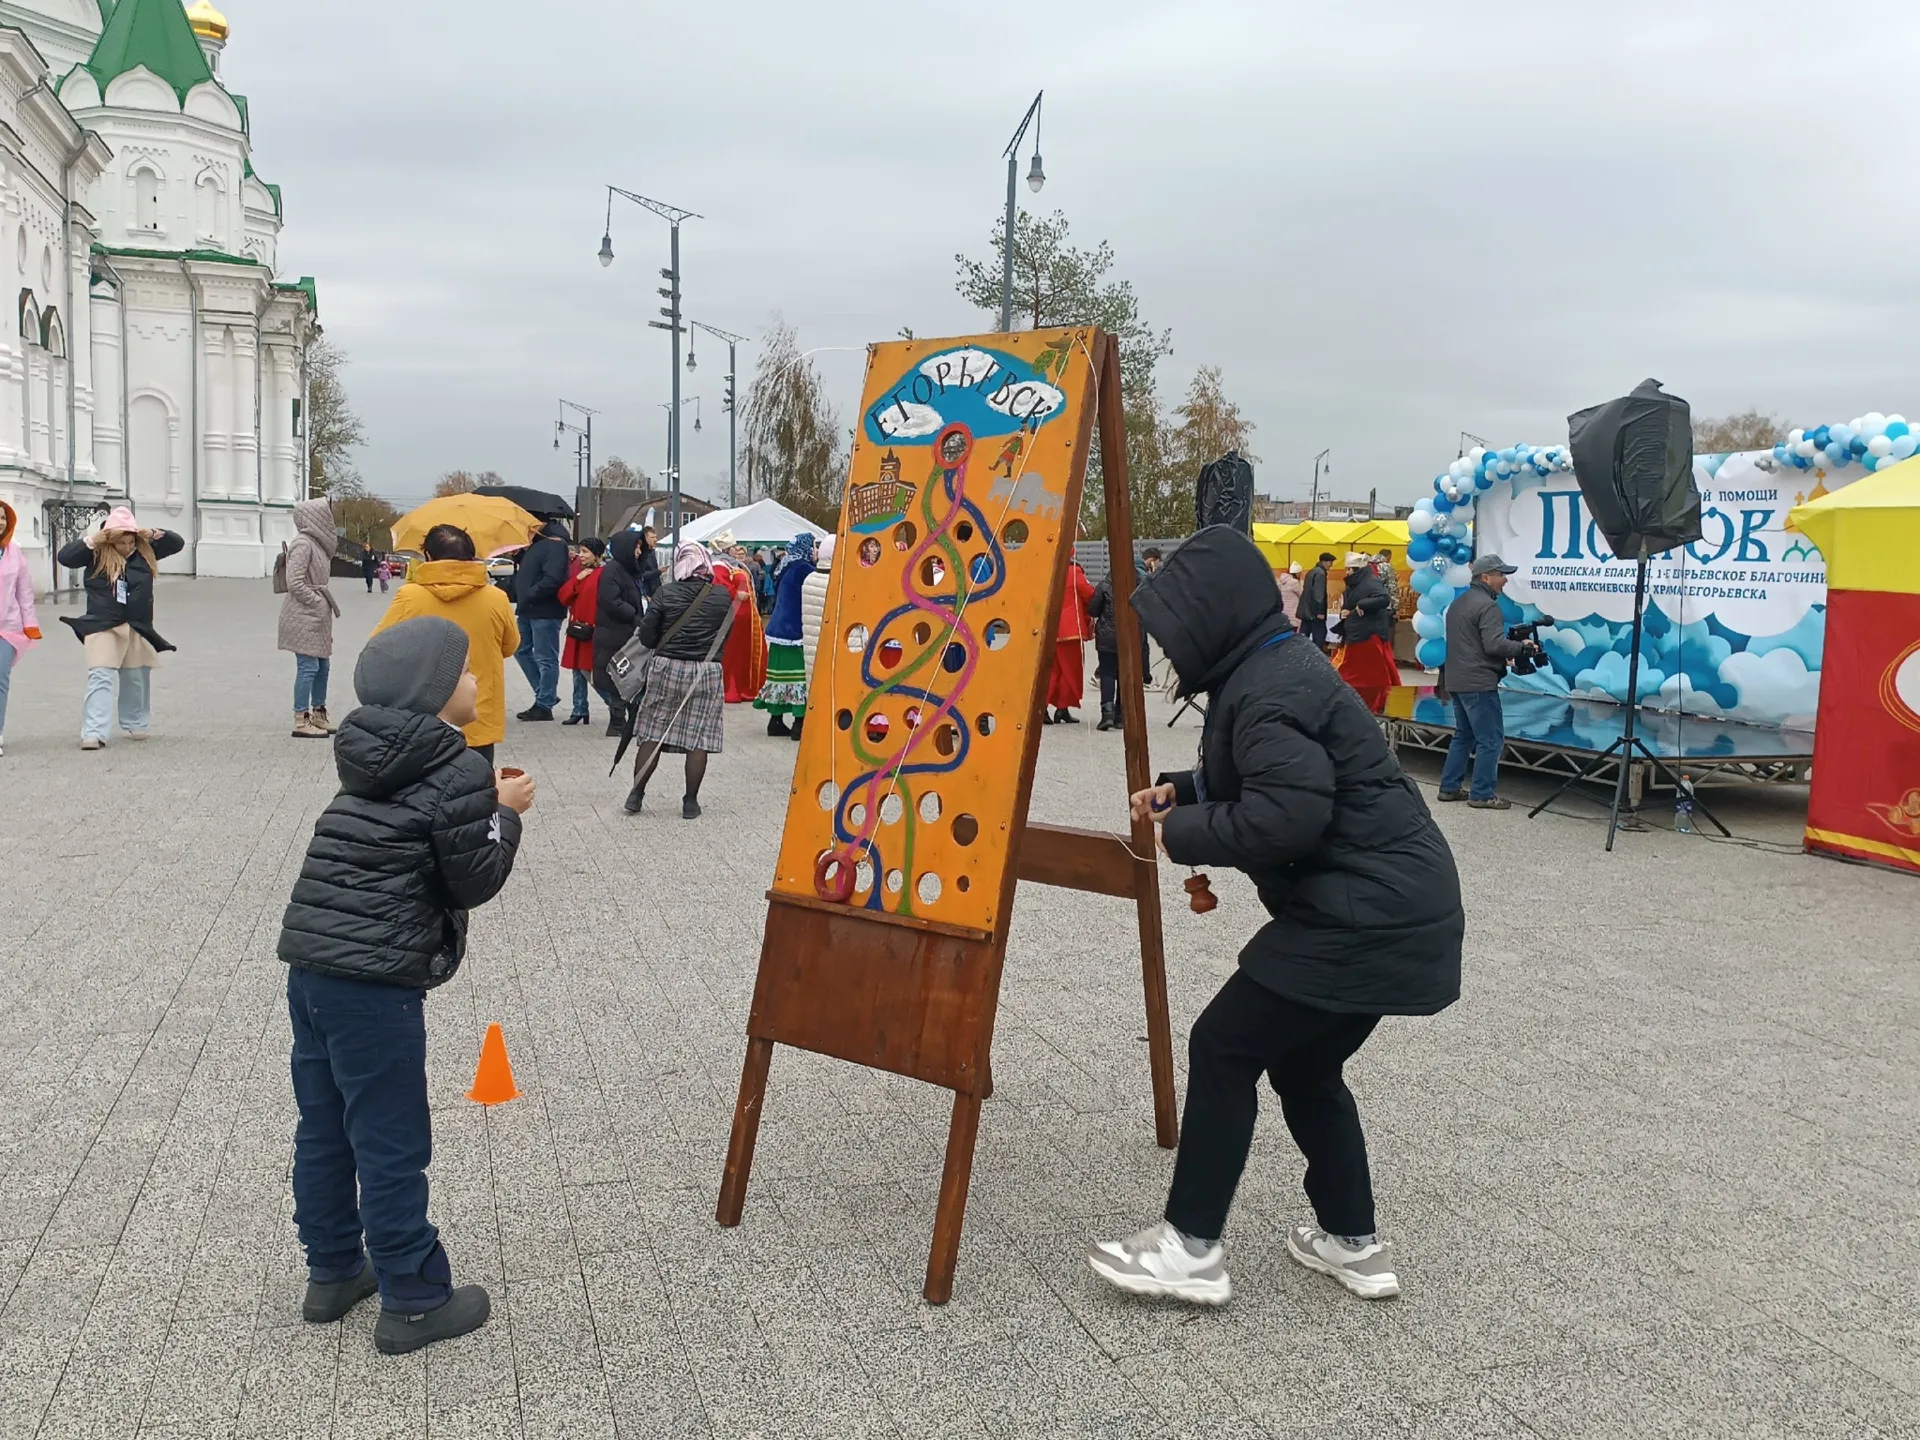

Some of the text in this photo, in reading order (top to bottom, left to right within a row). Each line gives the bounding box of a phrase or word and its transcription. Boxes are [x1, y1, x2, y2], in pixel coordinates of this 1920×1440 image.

[1719, 489, 1778, 502] ПОМОЩИ
[1531, 565, 1601, 577] КОЛОМЕНСКАЯ
[1530, 580, 1567, 592] ПРИХОД
[1569, 582, 1650, 594] АЛЕКСИЕВСКОО
